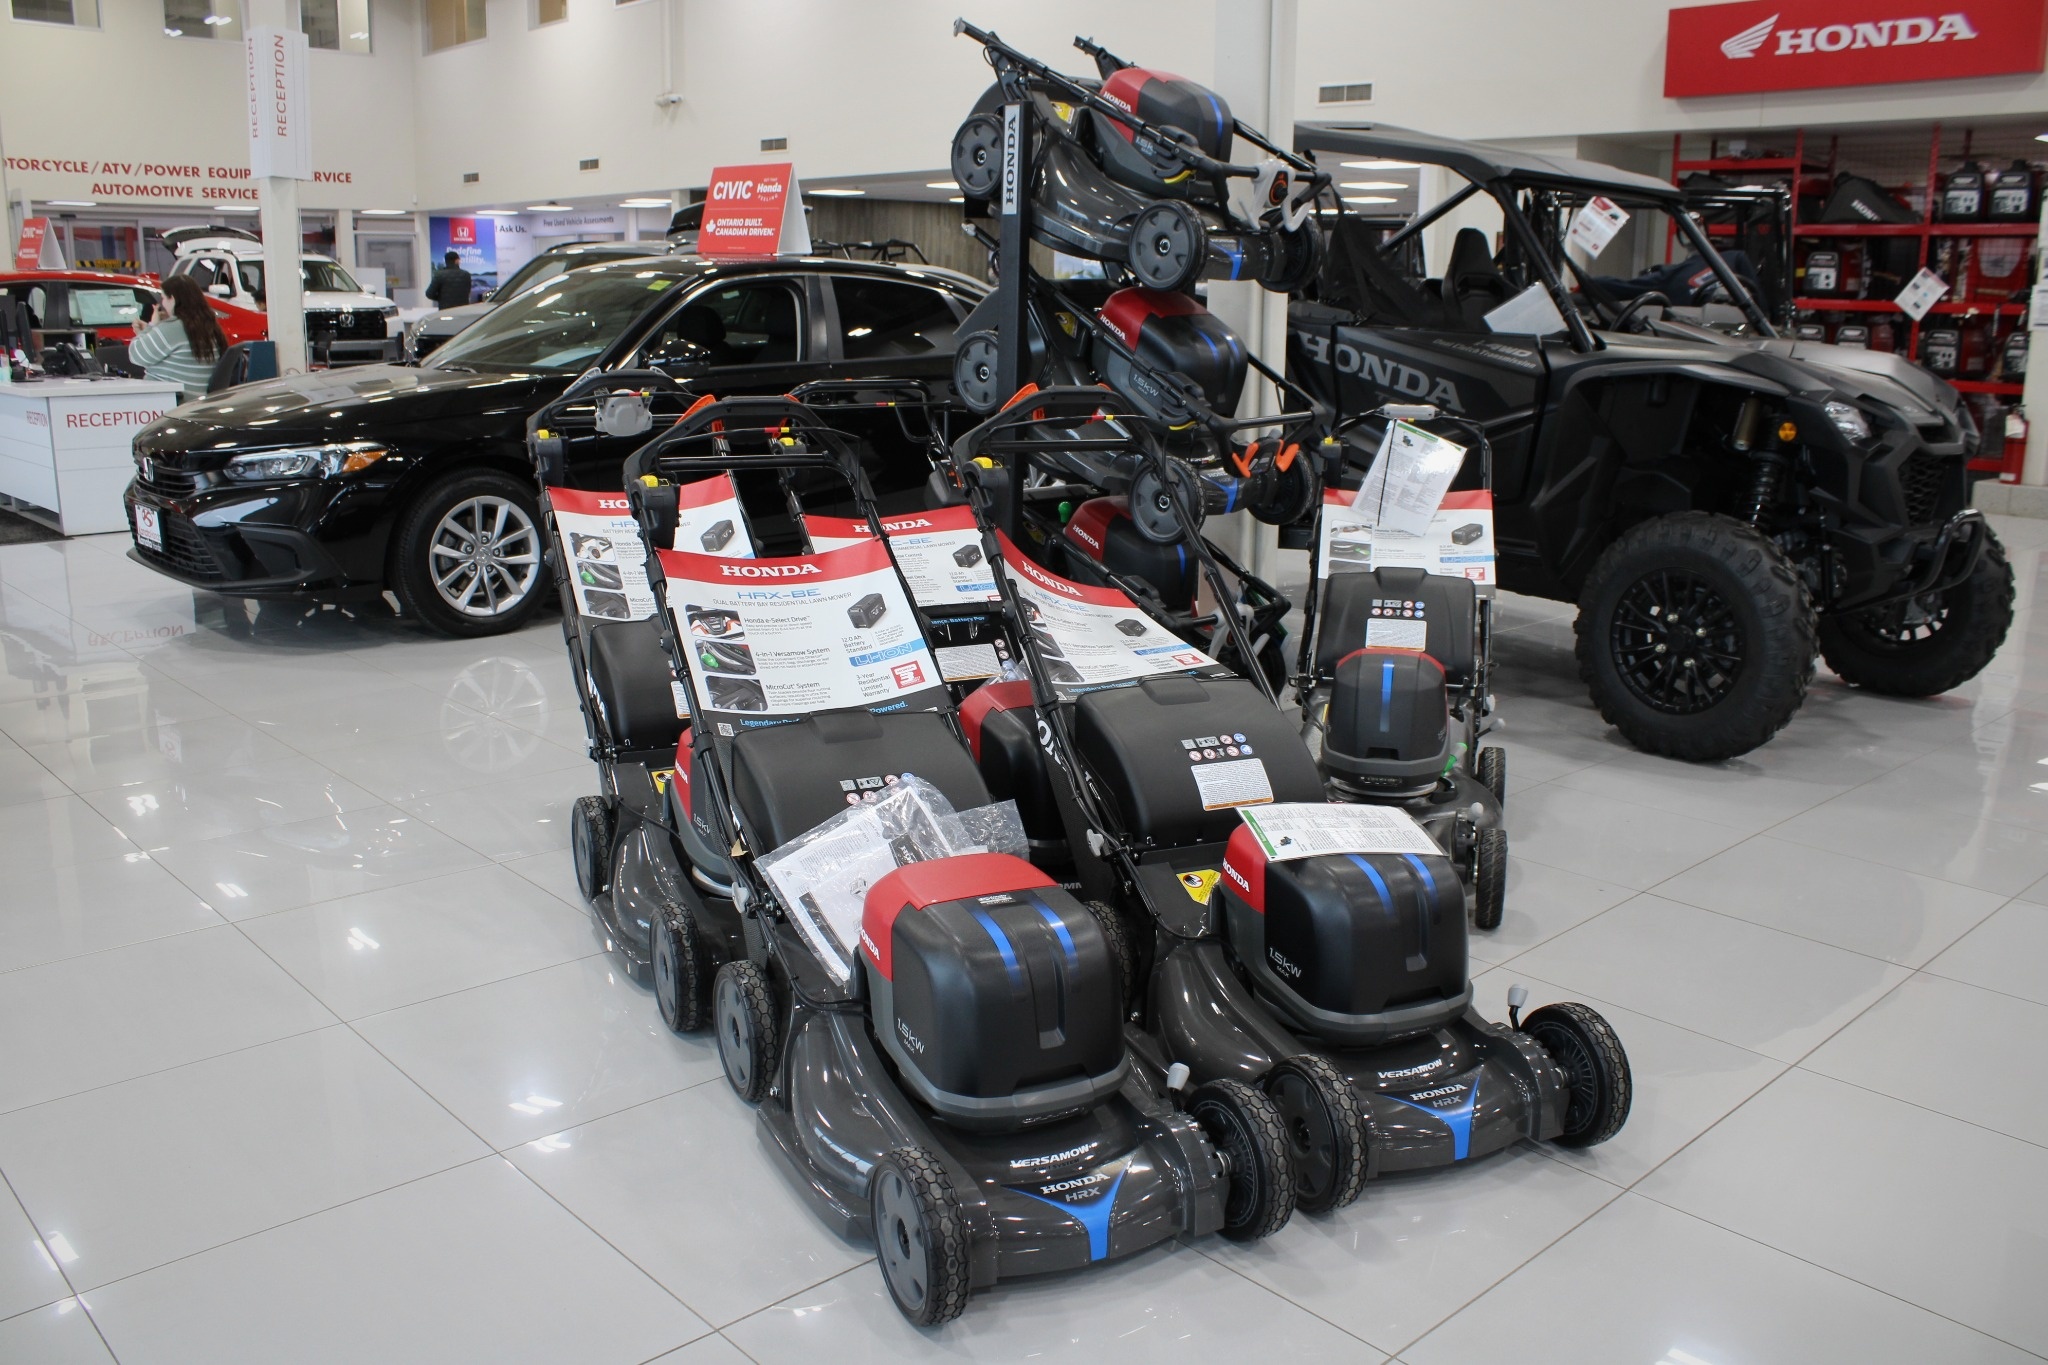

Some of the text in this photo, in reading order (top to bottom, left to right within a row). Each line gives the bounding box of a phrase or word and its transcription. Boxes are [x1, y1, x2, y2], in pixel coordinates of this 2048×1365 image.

[1774, 13, 1979, 57] HONDA
[248, 37, 259, 138] RECEPTION
[273, 34, 287, 137] RECEPTION
[1102, 90, 1132, 113] HONDA
[1005, 114, 1016, 206] HONDA
[208, 167, 251, 180] EQUIP
[311, 170, 352, 184] RVICE
[91, 183, 259, 201] AUTOMOTIVE SERVICE
[712, 180, 754, 200] CIVIC
[757, 182, 782, 193] Honda
[499, 225, 513, 233] Ask
[515, 225, 528, 233] Us.
[566, 216, 582, 226] Vehicle
[716, 218, 763, 227] ONTARIO BUILT.
[715, 228, 748, 236] CANADIAN
[1100, 314, 1126, 341] HONDA
[1480, 349, 1537, 369] Transmission
[1301, 332, 1466, 414] HONDA
[853, 518, 933, 533] HNDA
[1072, 524, 1100, 550] HONDA
[720, 563, 823, 577] HONDA
[1021, 560, 1084, 597] HONDA
[712, 598, 729, 606] DUAL
[769, 599, 810, 607] RESIDENTIAL
[809, 596, 828, 605] LAWN
[828, 592, 853, 601] MOWER
[736, 588, 821, 600] HRX-BE
[806, 647, 831, 656] System
[843, 640, 866, 649] Battery
[845, 643, 873, 654] Standard
[856, 671, 876, 680] 3-Year
[858, 674, 891, 686] Residential
[796, 681, 821, 690] System
[860, 683, 884, 692] Limited
[862, 687, 891, 698] Warranty
[1222, 856, 1250, 893] HONDA
[859, 926, 880, 961] ONDA
[1269, 947, 1302, 978] 1.5kW
[897, 1017, 925, 1055] 1.5kW
[1377, 1058, 1443, 1079] VERSAMOW
[1409, 1083, 1468, 1101] HONDA
[1432, 1095, 1462, 1108] HRX
[1009, 1143, 1090, 1169] VERSAMOW
[1040, 1173, 1111, 1195] HONDA
[1065, 1186, 1101, 1202] HRX
